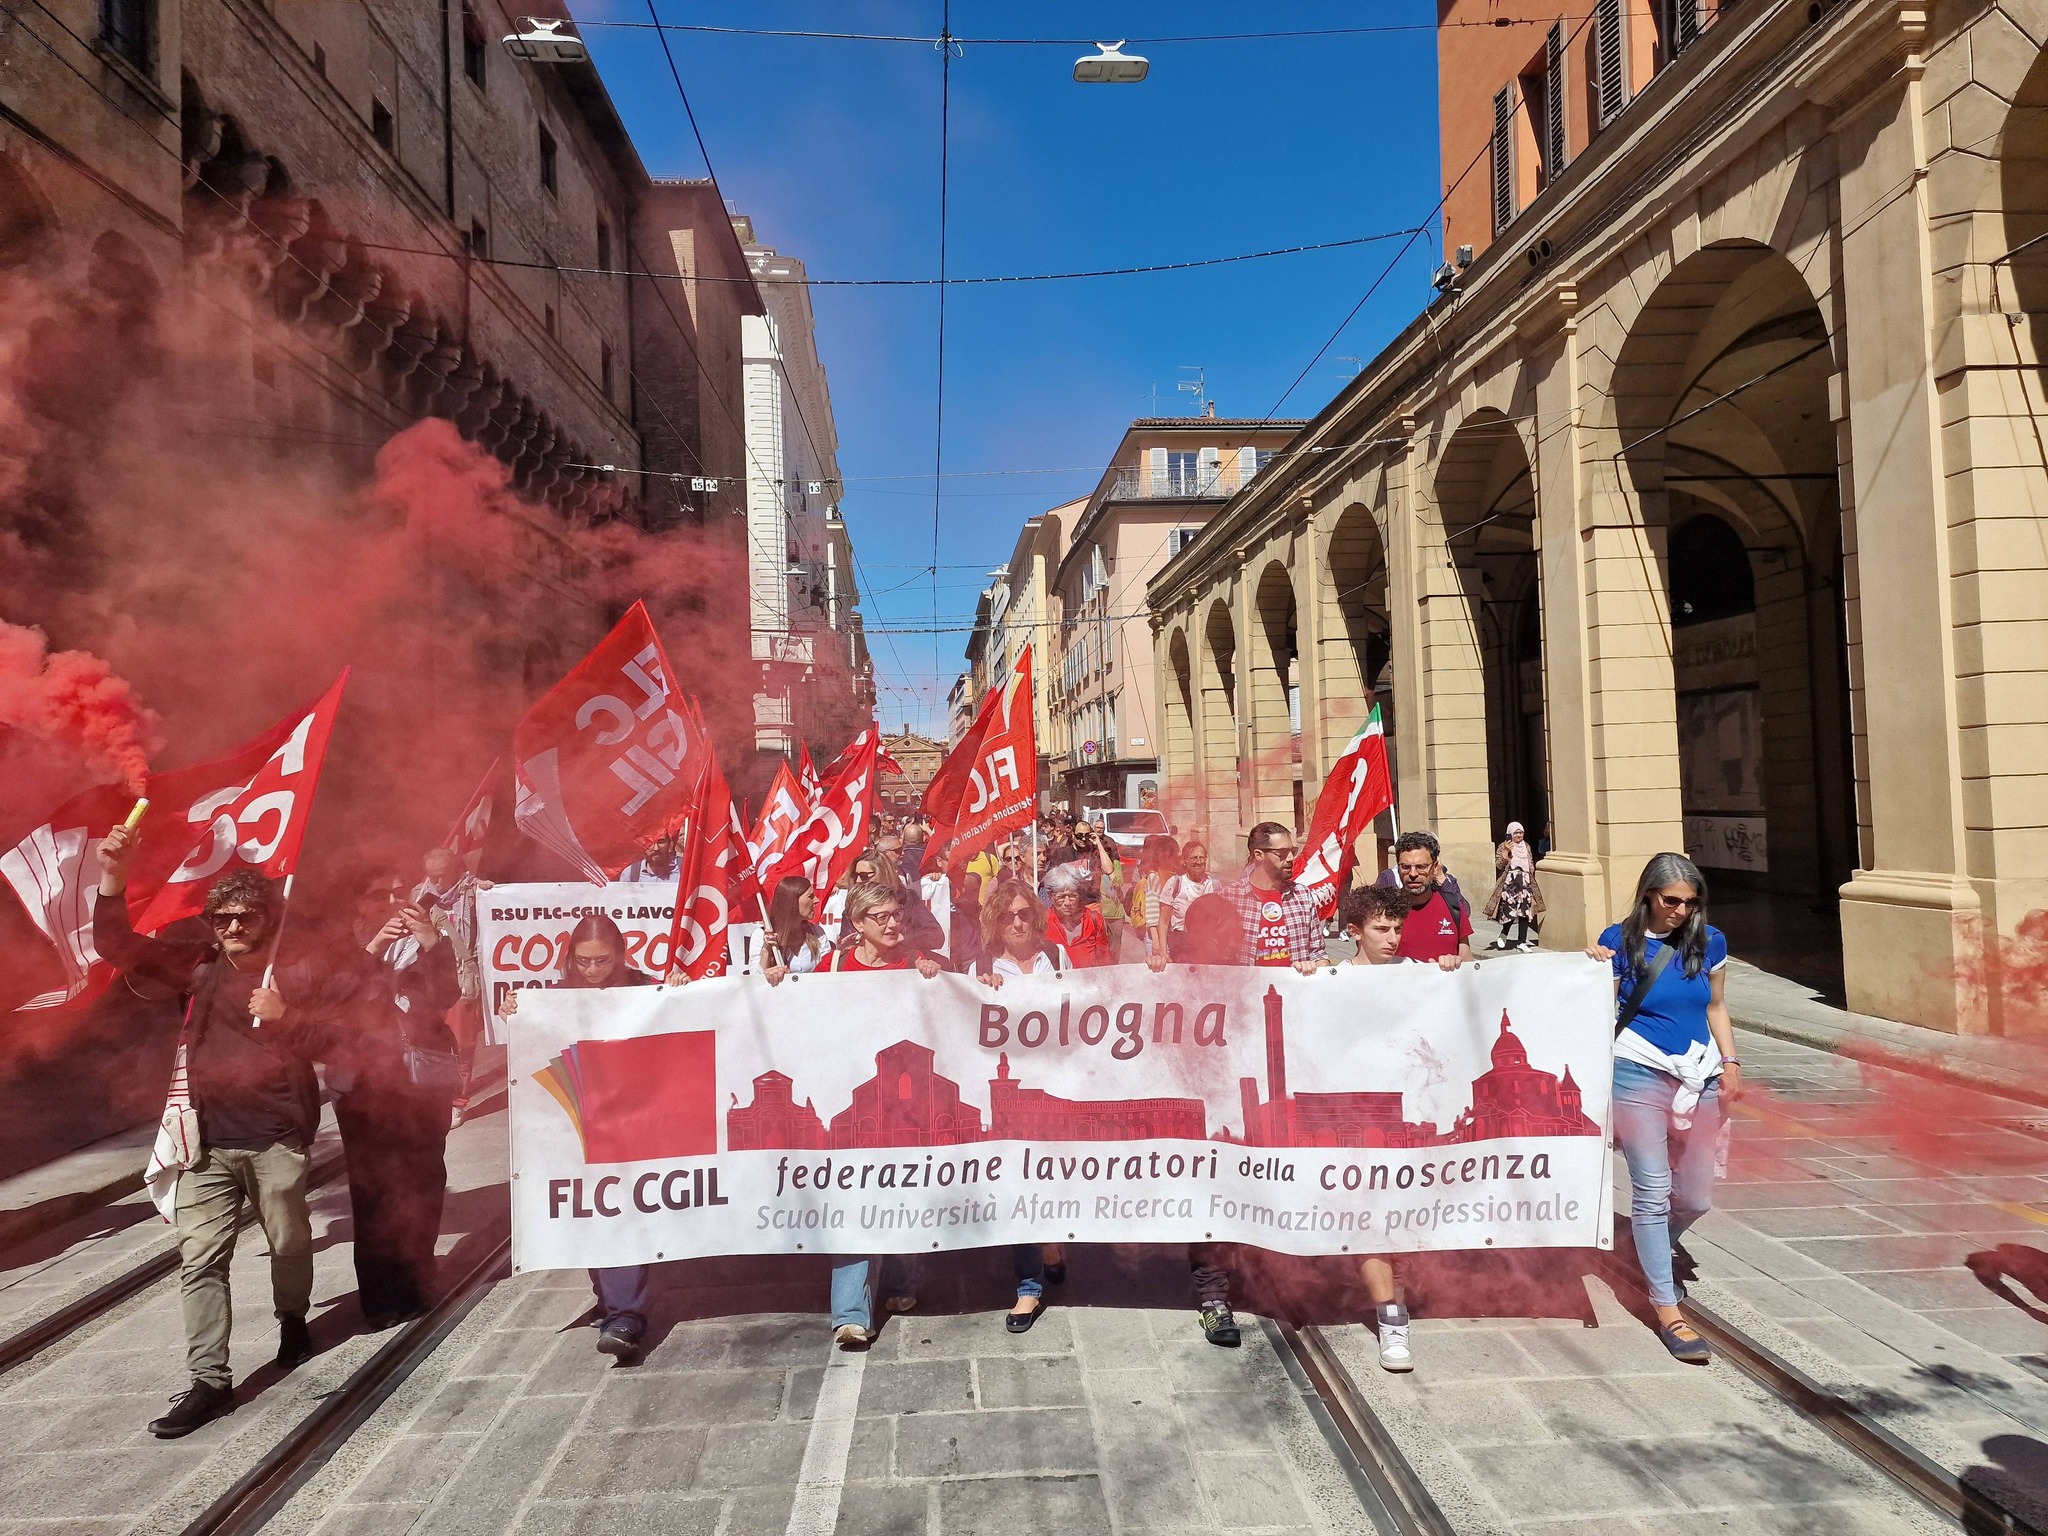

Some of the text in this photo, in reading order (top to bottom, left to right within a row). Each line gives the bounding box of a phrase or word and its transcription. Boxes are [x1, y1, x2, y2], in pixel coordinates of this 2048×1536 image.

[491, 908, 529, 921] RSU
[611, 909, 623, 919] e
[627, 907, 675, 919] LAVO
[1256, 948, 1291, 961] PEAC
[1265, 938, 1286, 947] FOR
[978, 992, 1227, 1060] Bologna
[549, 1167, 729, 1219] FLC CGIL
[776, 1148, 1551, 1197] federazione lavoratori della conoscenza
[756, 1192, 1579, 1235] Scuola Università Afam Ricerca Formazione professionale
